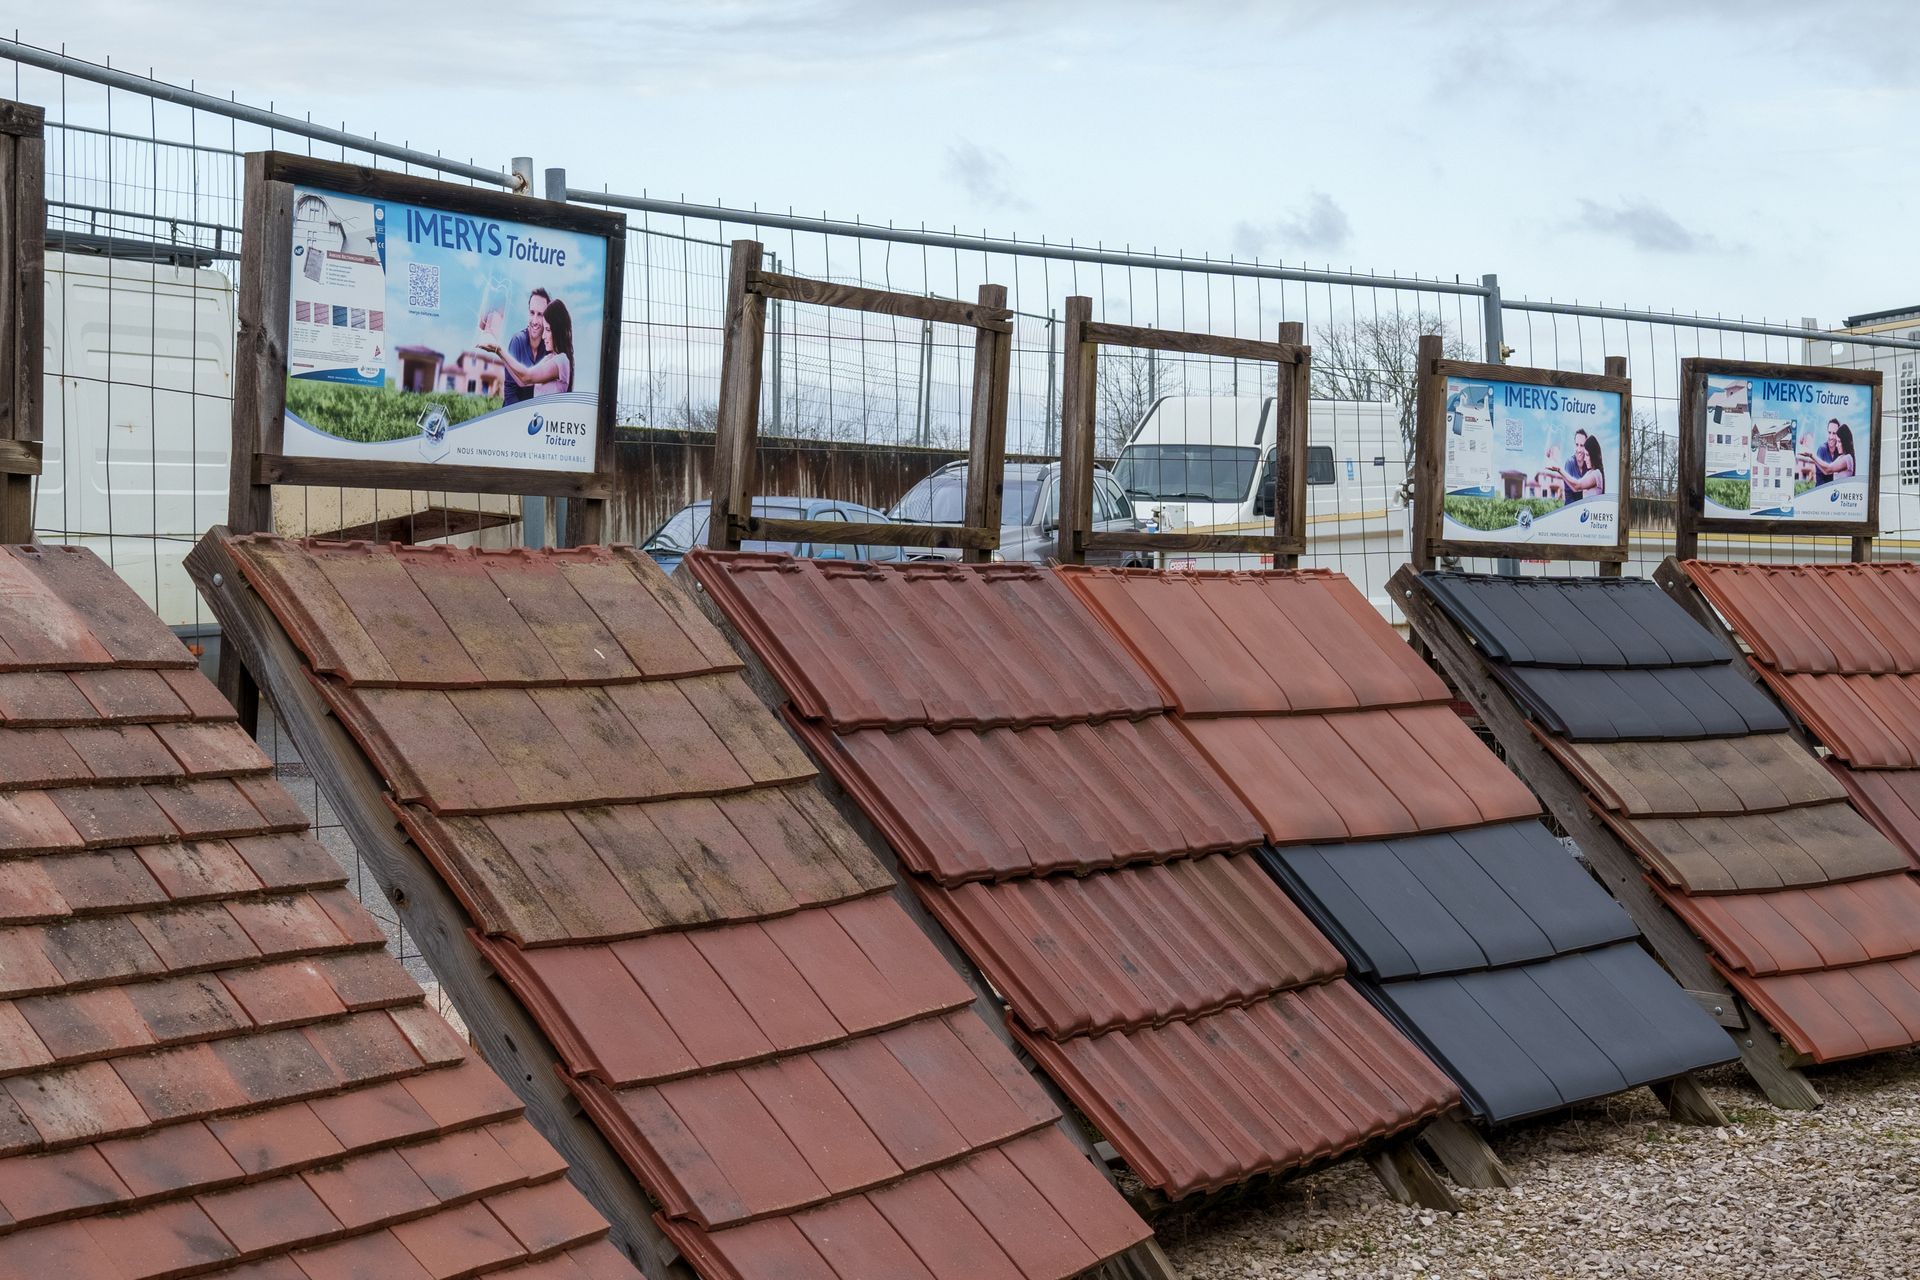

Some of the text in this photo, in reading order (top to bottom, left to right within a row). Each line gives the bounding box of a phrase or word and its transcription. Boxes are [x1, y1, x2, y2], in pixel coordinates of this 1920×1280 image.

[406, 209, 566, 267] IMERYS Toiture
[1505, 385, 1596, 415] IMERYS Toiture
[1763, 381, 1849, 406] IMERYS Toiture
[545, 420, 586, 436] IMERYS
[545, 434, 576, 447] Toiture
[456, 447, 587, 463] NOUS INNOVONS POUR L'HABITAT DURABLE
[1840, 492, 1863, 501] IMERYS
[1840, 500, 1858, 508] Toiture
[1590, 512, 1614, 522] IMERYS
[1590, 521, 1608, 530] Toiture
